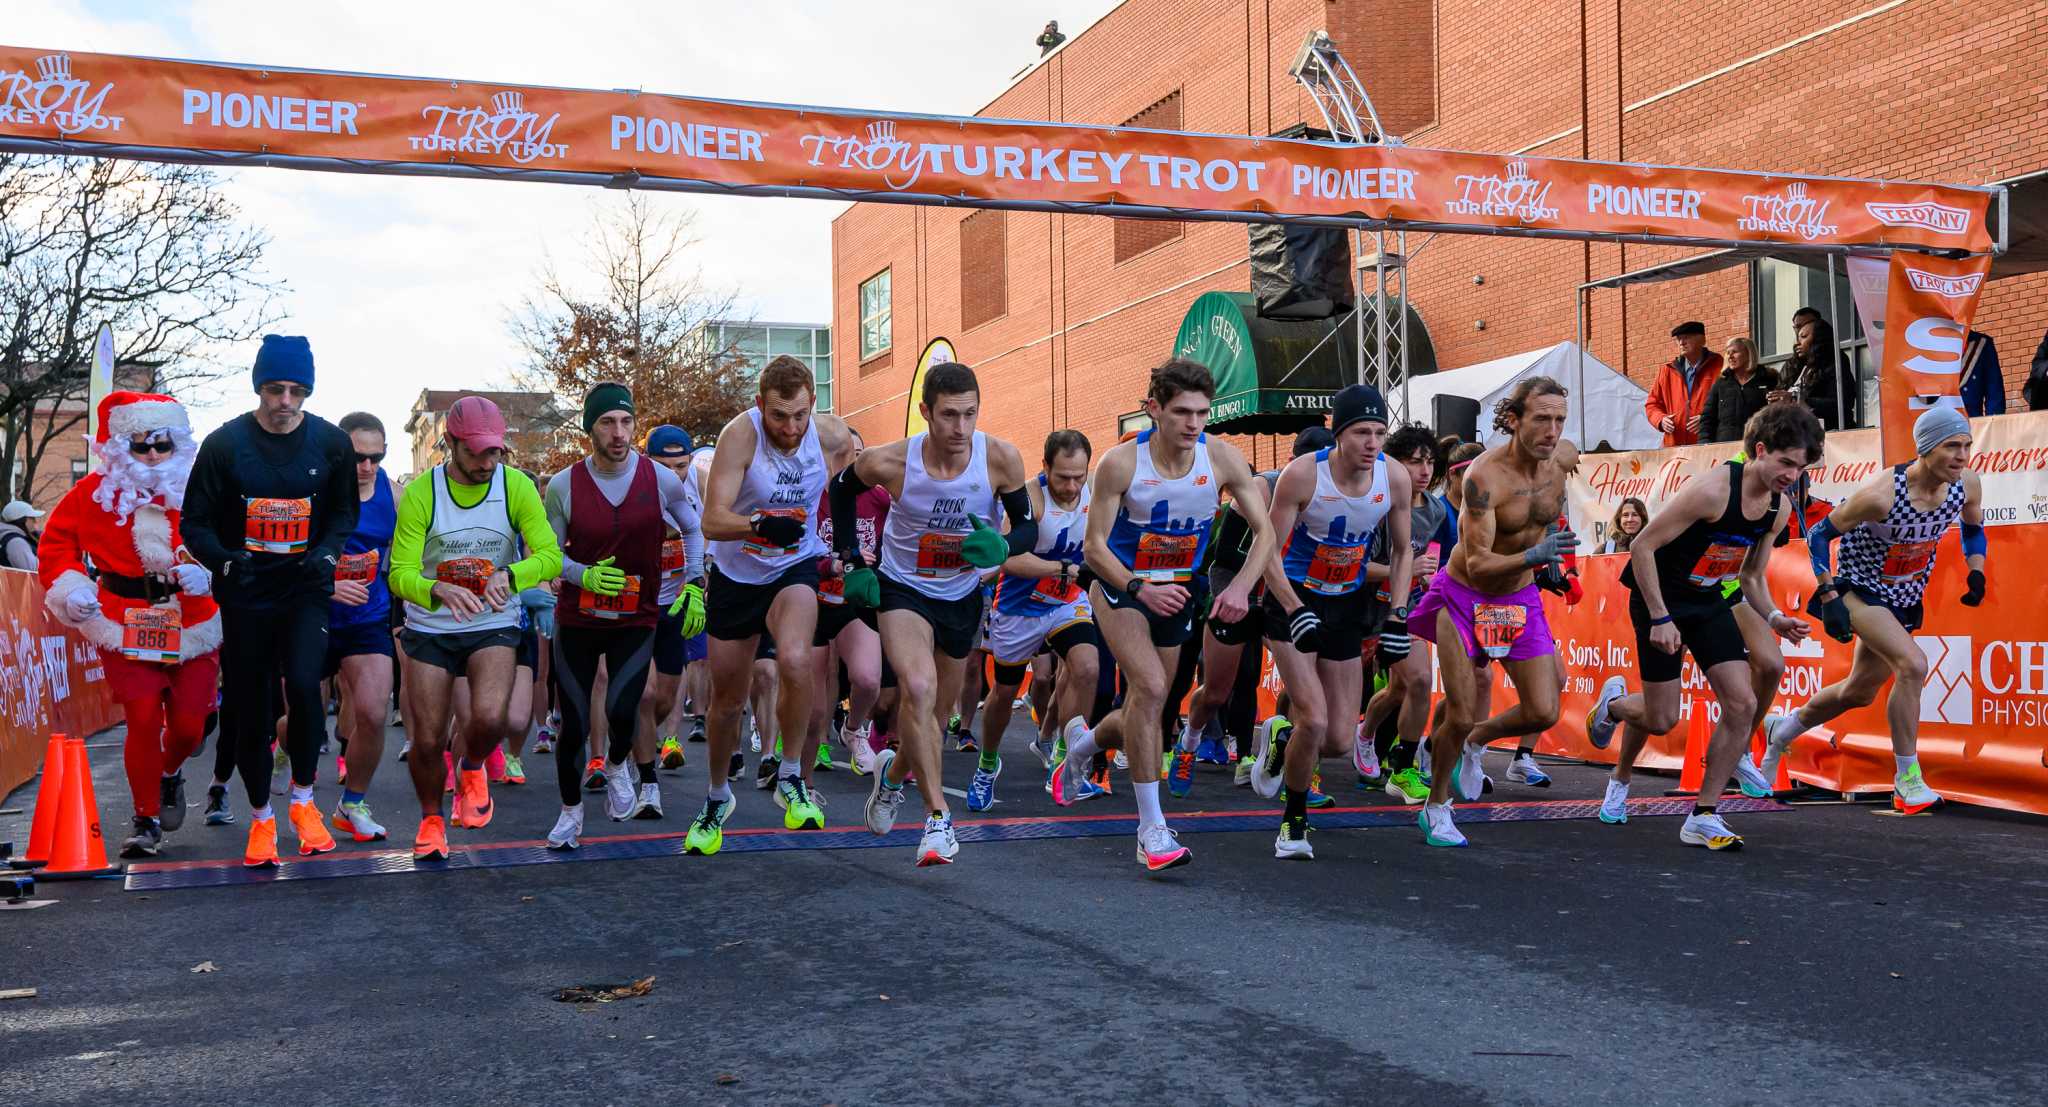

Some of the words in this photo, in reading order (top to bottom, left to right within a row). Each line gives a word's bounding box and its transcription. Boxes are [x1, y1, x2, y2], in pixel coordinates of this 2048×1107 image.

[0, 69, 114, 134] ROY
[183, 88, 358, 136] PIONEER
[0, 106, 47, 125] KEY
[53, 111, 124, 131] TROT
[422, 105, 560, 164] TROY
[408, 137, 509, 155] TURKEY
[510, 141, 569, 159] TROT
[611, 115, 764, 162] PIONEER
[799, 134, 930, 191] TROY
[920, 143, 1131, 184] TURKEY
[1139, 154, 1266, 192] TROT
[1293, 164, 1416, 201] PIONEER
[1455, 174, 1552, 223] TROY
[1446, 201, 1520, 217] TURKEY
[1520, 206, 1559, 220] TROT
[1588, 183, 1701, 220] PIONEER
[1742, 194, 1830, 240] TROY
[1737, 218, 1799, 234] TURKEY
[1799, 223, 1838, 237] TROT
[1217, 401, 1240, 418] BINGO
[1589, 462, 1656, 505] Happy
[1832, 461, 1876, 484] our
[932, 498, 967, 513] RUN
[258, 523, 299, 539] 1111
[137, 630, 167, 648] 858
[1568, 639, 1603, 672] Sons,
[1607, 640, 1632, 668] Inc.
[1777, 665, 1822, 697] GION
[1980, 640, 2048, 694] CH
[1575, 677, 1594, 694] 1910
